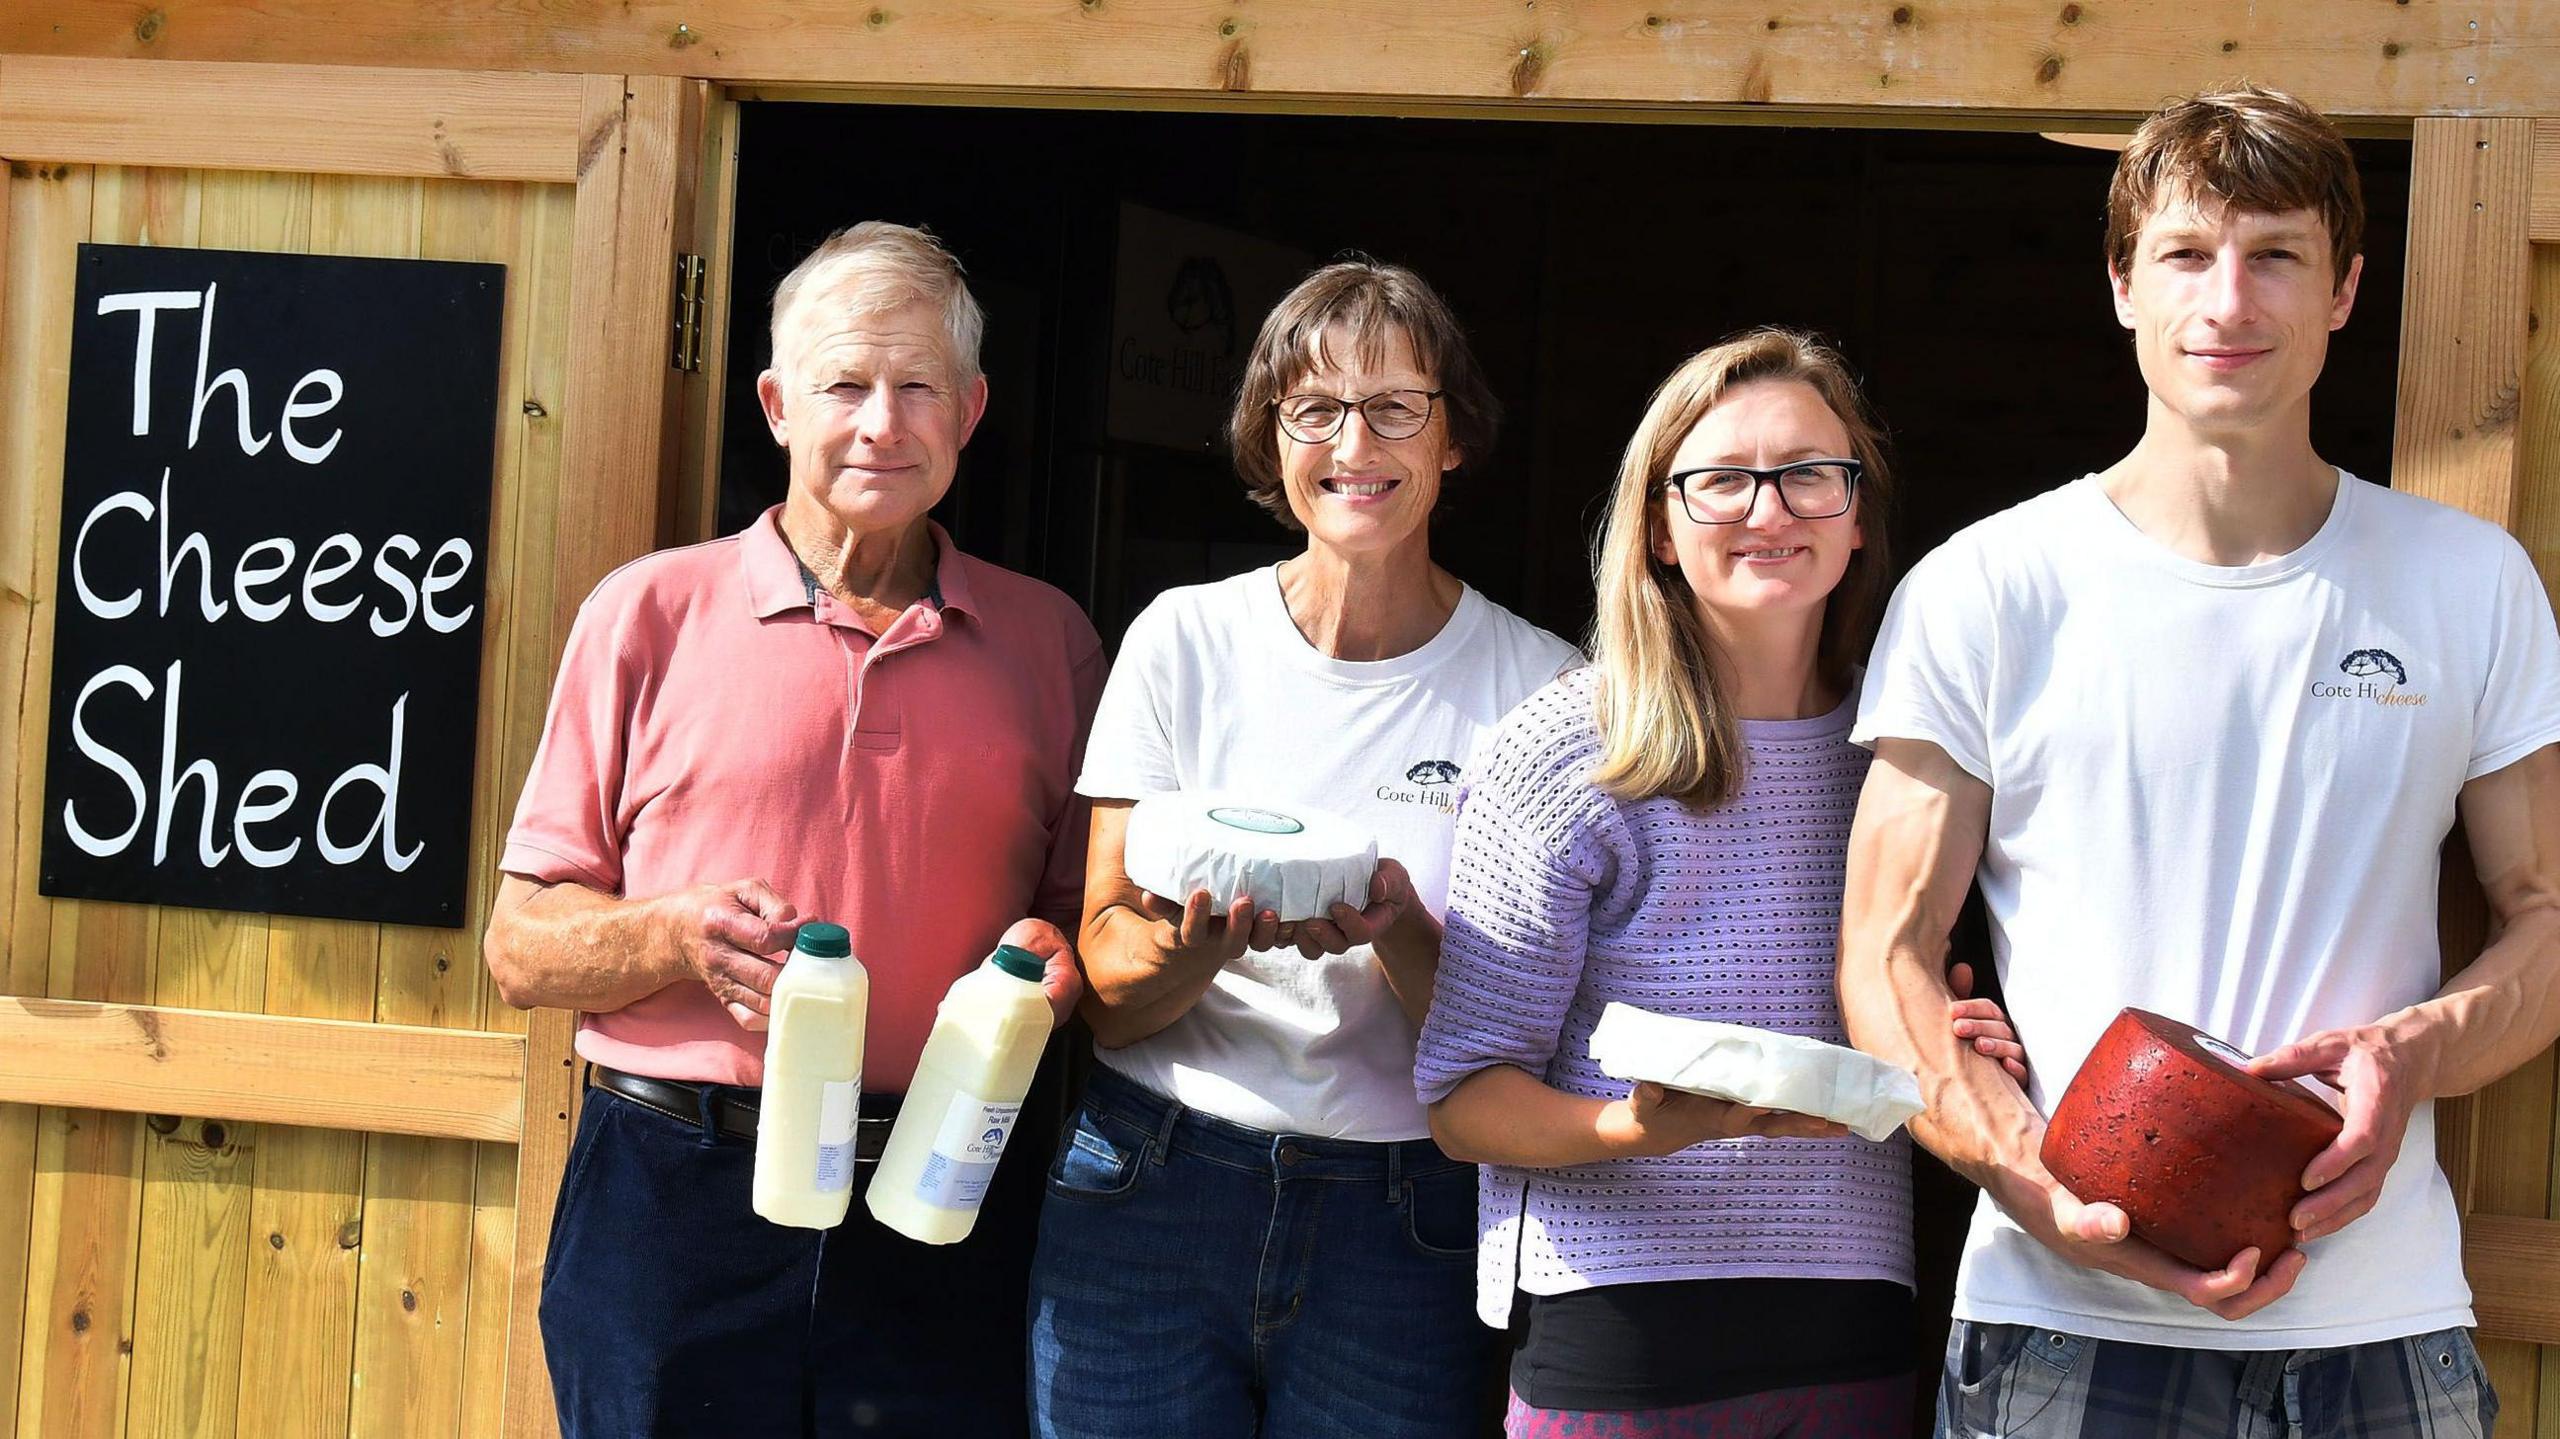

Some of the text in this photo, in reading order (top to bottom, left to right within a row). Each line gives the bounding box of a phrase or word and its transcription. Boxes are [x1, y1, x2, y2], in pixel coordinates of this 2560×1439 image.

[98, 282, 343, 464] The
[72, 466, 475, 637] Cheese
[2311, 681, 2352, 698] Cote
[2376, 684, 2428, 706] cheese
[63, 660, 425, 873] Shed
[1377, 786, 1449, 807] Cote Hill
